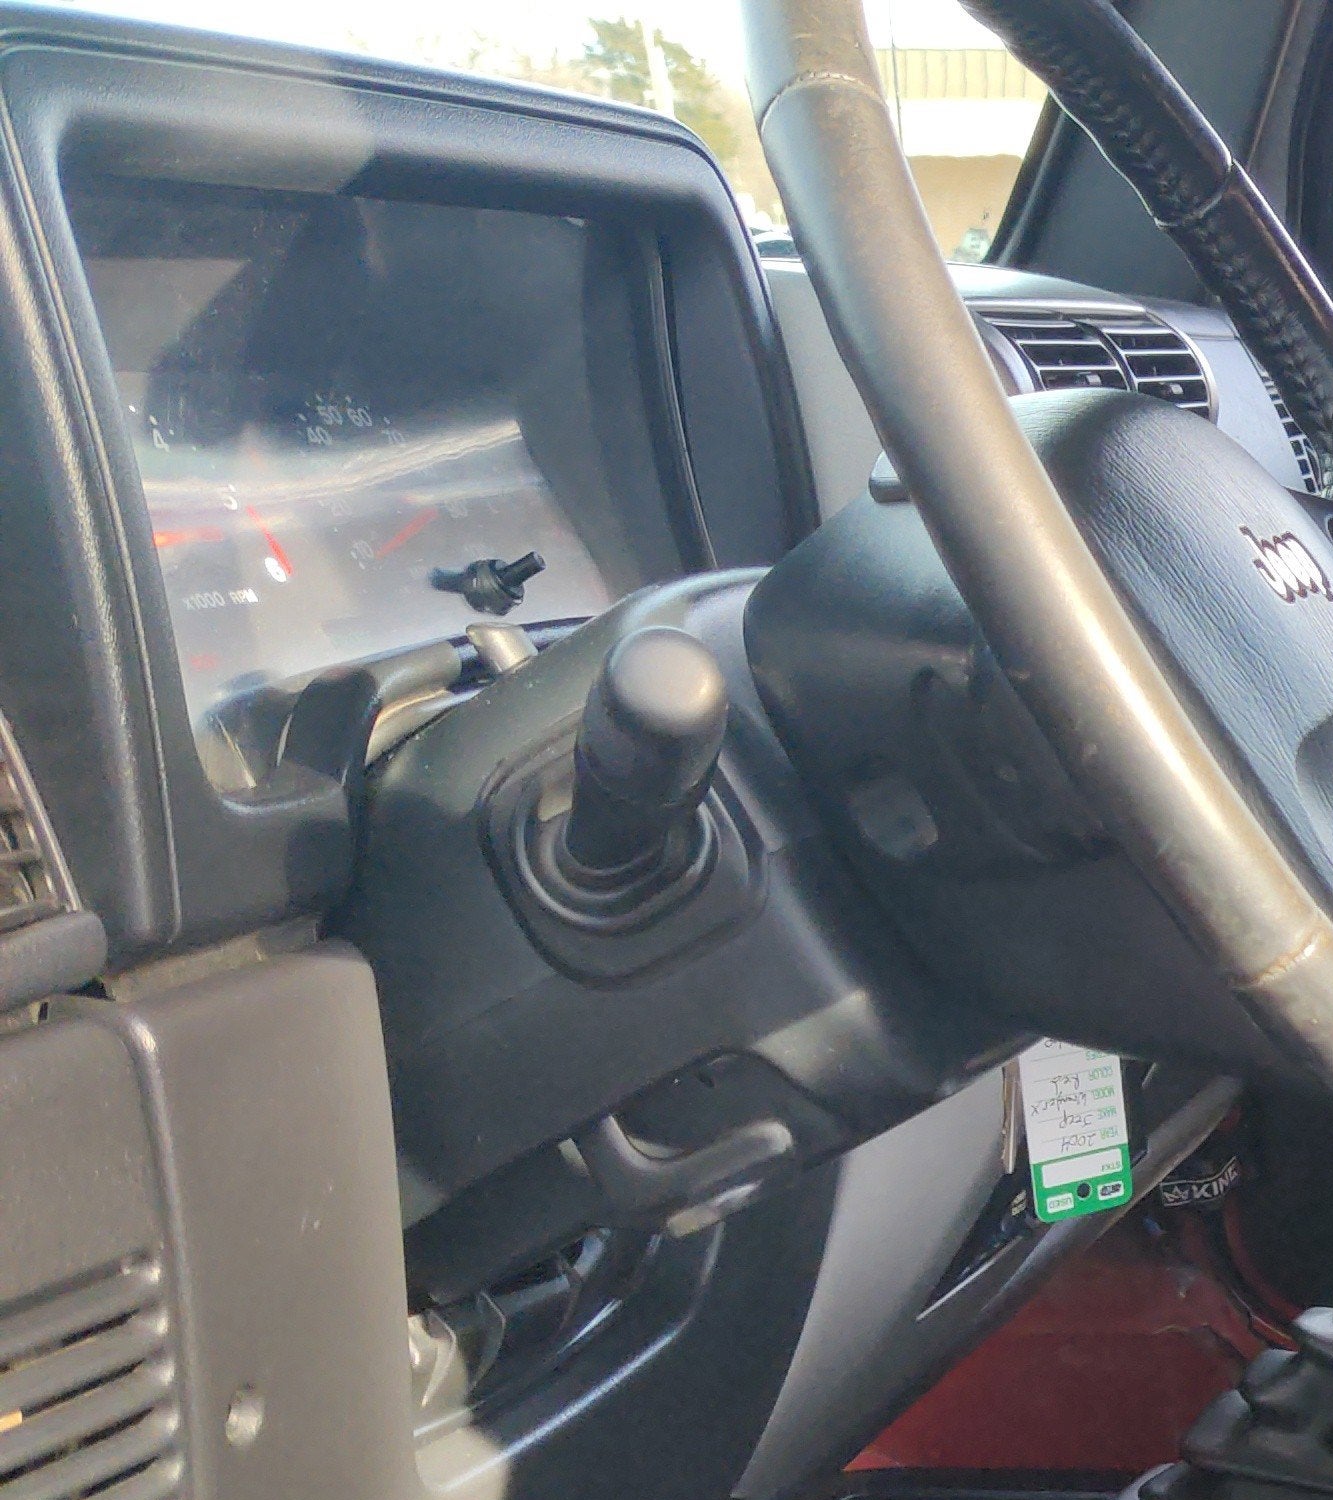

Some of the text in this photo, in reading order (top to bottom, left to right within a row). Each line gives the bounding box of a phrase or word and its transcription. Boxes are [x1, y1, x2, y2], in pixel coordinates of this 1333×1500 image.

[316, 405, 372, 427] 50 60
[153, 428, 169, 452] 4
[306, 426, 332, 445] 40
